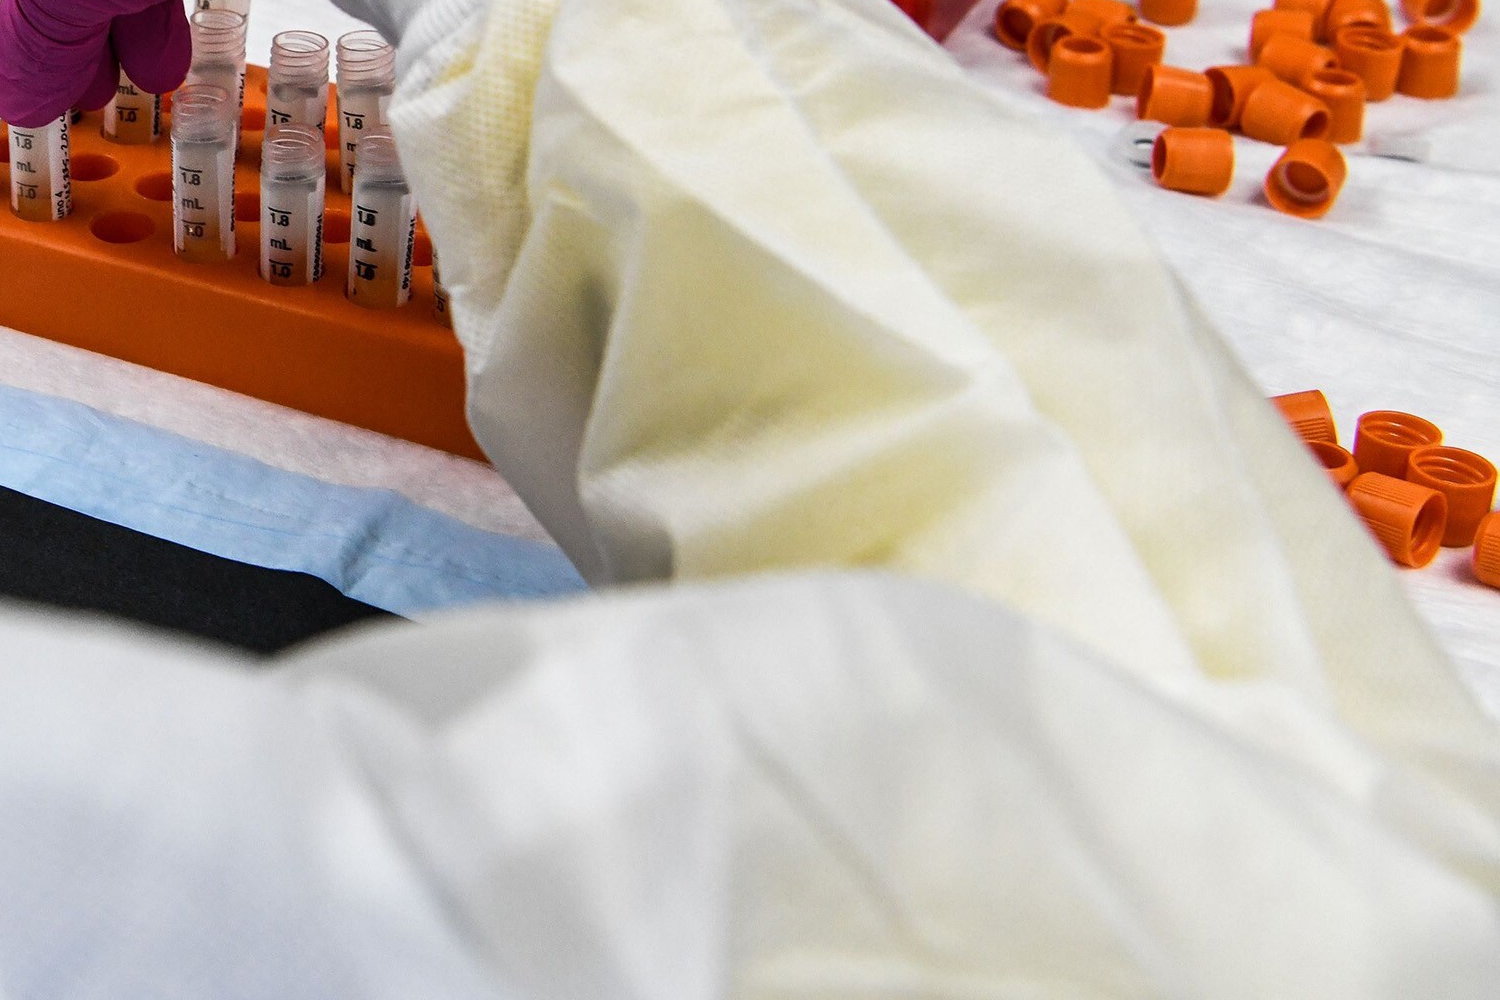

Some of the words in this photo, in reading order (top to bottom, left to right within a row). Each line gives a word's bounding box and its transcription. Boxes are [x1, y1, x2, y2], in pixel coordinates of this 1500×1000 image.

[117, 85, 138, 96] mL
[118, 110, 137, 123] 1.0
[346, 116, 364, 130] 1.8
[15, 136, 32, 150] 1.8
[16, 161, 36, 173] mL
[181, 172, 200, 186] 1.8
[19, 186, 36, 199] 1.0
[182, 198, 204, 210] mL
[271, 213, 290, 227] 1.8
[357, 211, 376, 227] 1.8
[184, 225, 204, 238] 1.0
[270, 238, 292, 251] mL
[271, 265, 291, 278] 1.0
